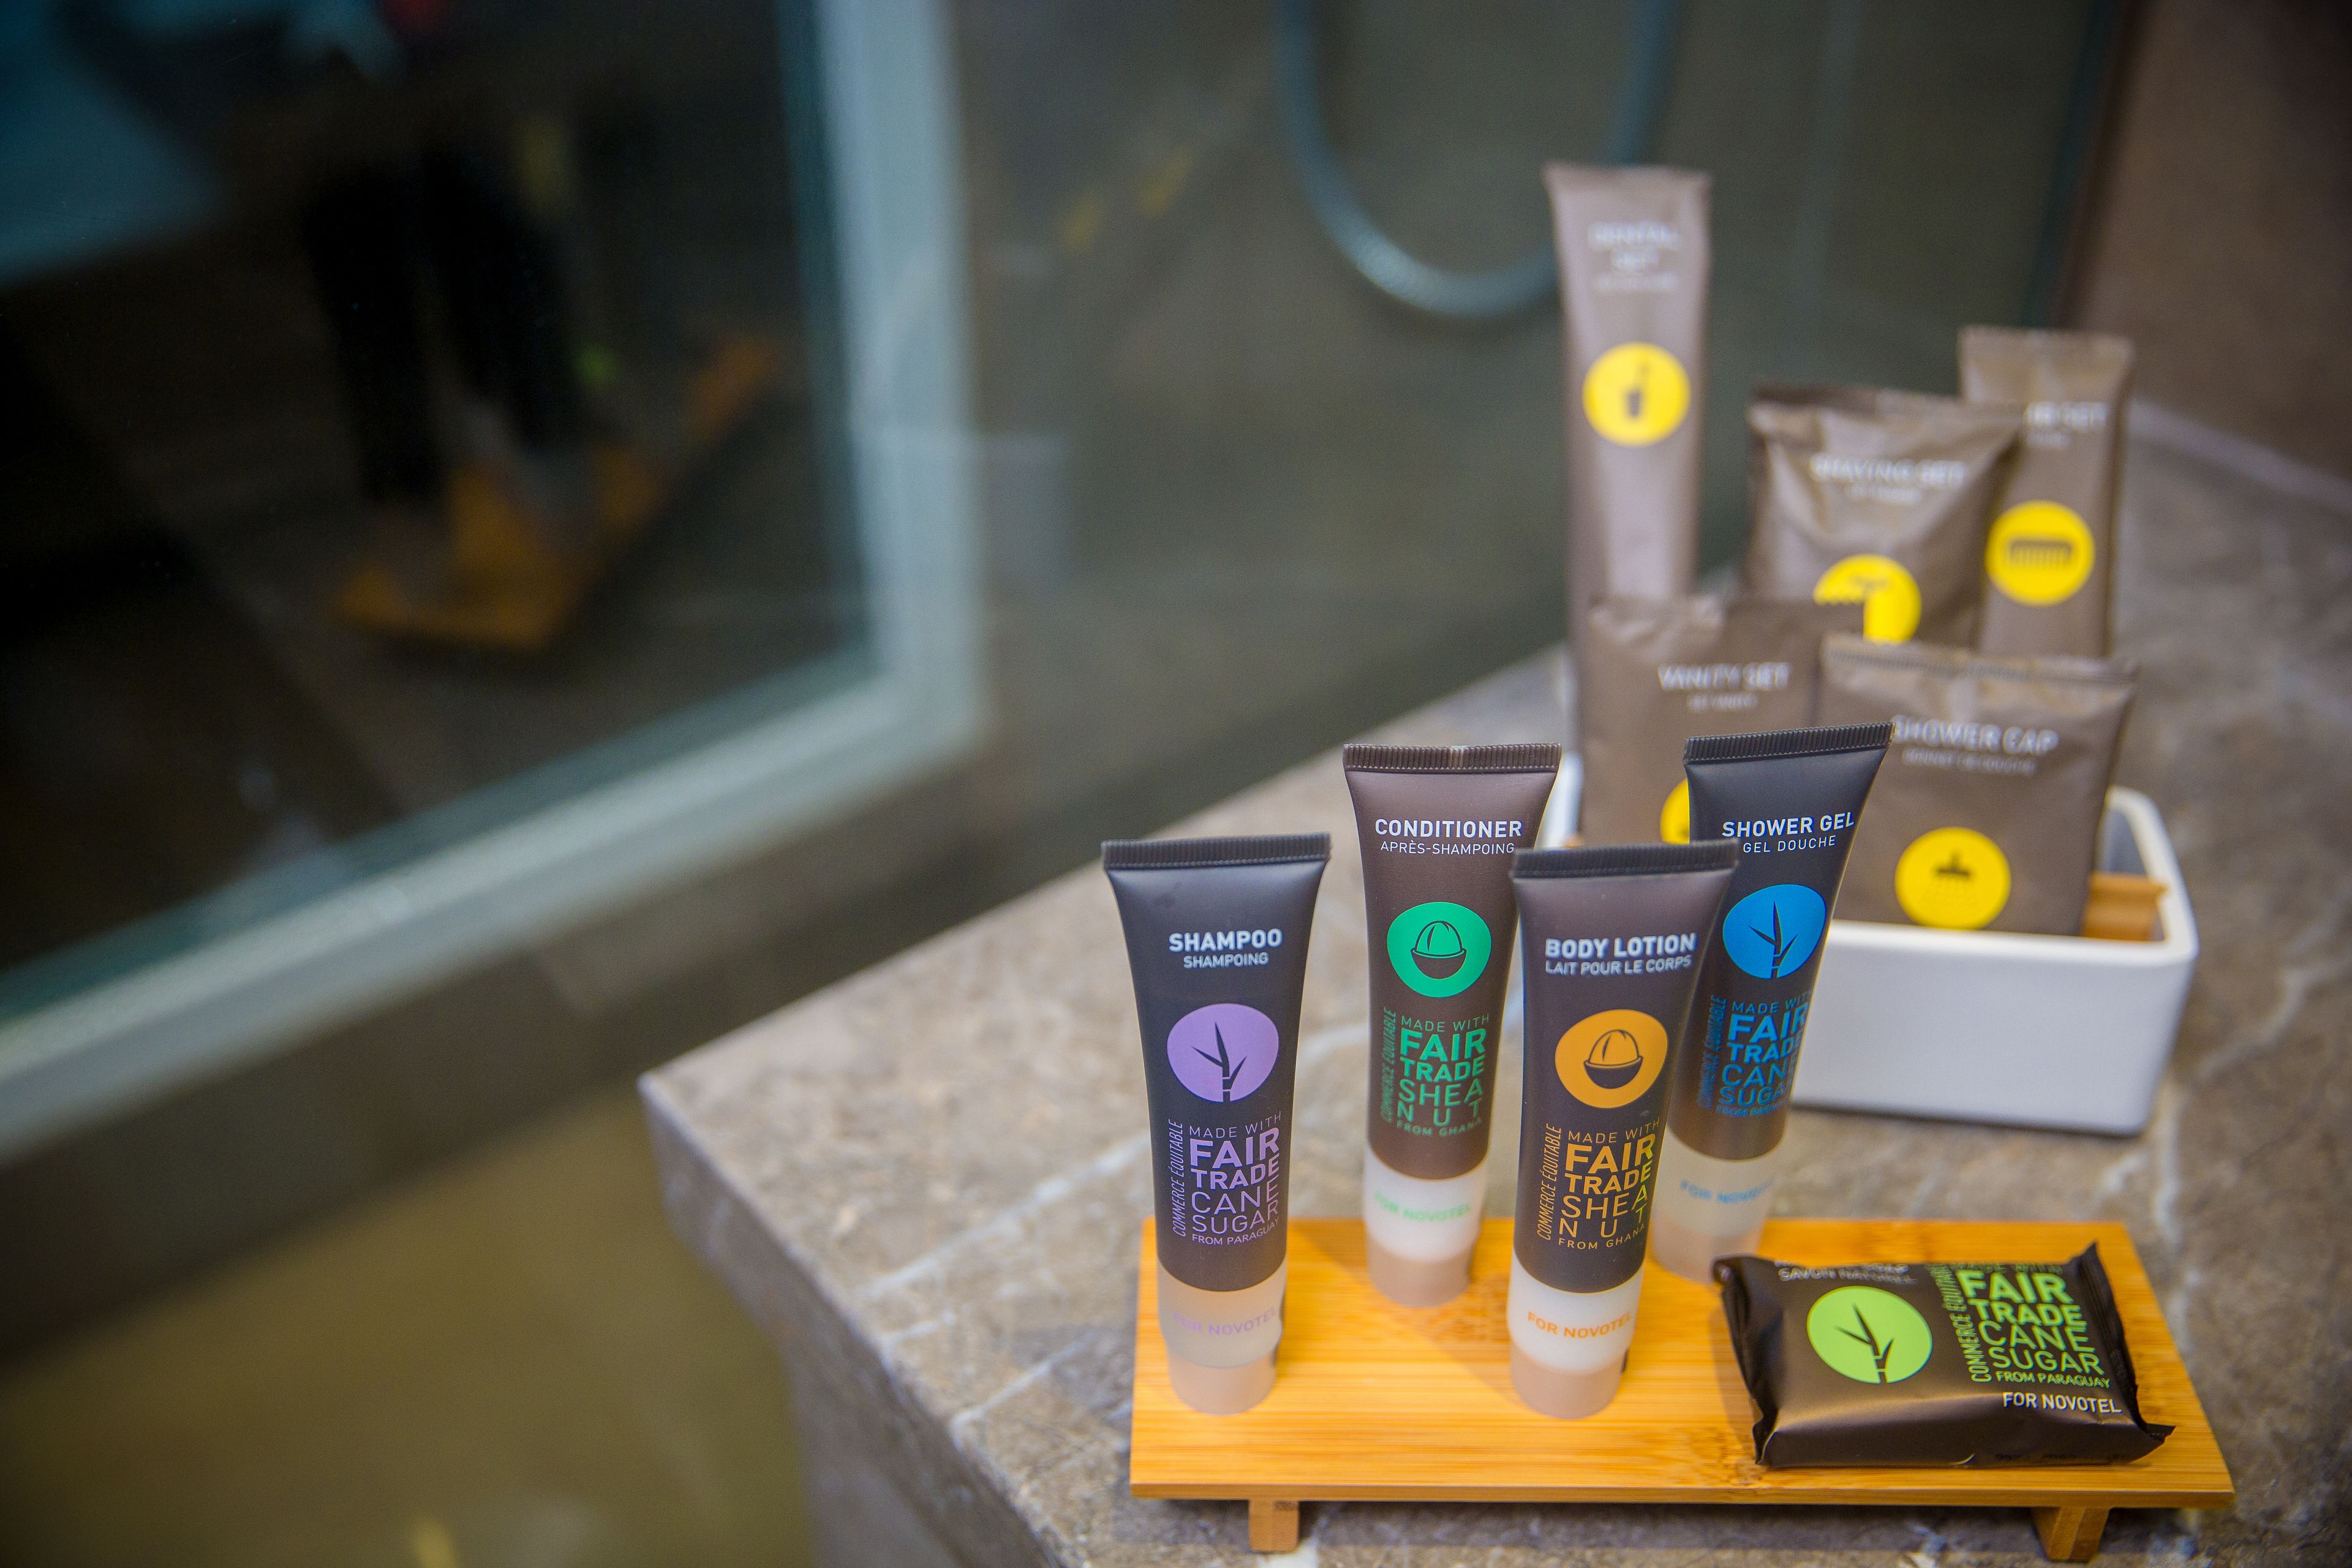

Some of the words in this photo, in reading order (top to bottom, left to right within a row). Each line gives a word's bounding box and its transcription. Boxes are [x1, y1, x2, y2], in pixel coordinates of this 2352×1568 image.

[1657, 664, 1743, 690] VANITY
[1744, 662, 1791, 690] SET
[1891, 715, 2001, 752] SHOWER
[2003, 726, 2060, 755] CAP
[1375, 818, 1521, 839] CONDITIONER
[1722, 817, 1813, 837] SHOWER
[1819, 812, 1855, 832] GEL
[1380, 840, 1515, 855] APRÈS-SHAMPOING
[1743, 842, 1771, 853] GEL
[1777, 835, 1836, 852] DOUCHE
[1169, 929, 1283, 952] SHAMPOO
[1545, 938, 1609, 959] BODY
[1614, 932, 1697, 958] LOTION
[1183, 952, 1269, 969] SHAMPOING
[1545, 960, 1577, 975] LAIT
[1580, 960, 1623, 976] POUR
[1624, 959, 1644, 974] LE
[1646, 954, 1692, 974] CORPS
[1401, 1016, 1446, 1032] MADE
[1452, 1013, 1490, 1031] WITH
[1728, 1002, 1810, 1043] FAIR
[1732, 1001, 1779, 1015] MADE
[1400, 1027, 1487, 1062] FAIR
[1400, 1054, 1486, 1083] TRADE
[1398, 1078, 1483, 1107] SHEA
[1189, 1126, 1237, 1138] MADE
[1245, 1111, 1281, 1134] WITH
[1397, 1097, 1482, 1127] NUT
[1568, 1130, 1618, 1144] MADE
[1625, 1117, 1660, 1140] WITH
[1168, 1119, 1184, 1178] ÉQUITABLE
[1190, 1128, 1280, 1169] FAIR
[1539, 1123, 1561, 1182] ÉQUITABLE
[1565, 1134, 1656, 1174] FAIR
[1191, 1153, 1280, 1189] TRADE
[1564, 1160, 1653, 1194] TRADE
[1171, 1176, 1186, 1237] COMMERCE
[1191, 1174, 1279, 1215] CANE
[1561, 1185, 1648, 1219] SHEA
[1192, 1199, 1278, 1234] SUGAR
[1537, 1180, 1557, 1240] COMMERCE
[1559, 1203, 1648, 1238] NUT
[1192, 1234, 1223, 1245] FROM
[1227, 1216, 1279, 1245] PARAGUAY
[1558, 1237, 1597, 1250] FROM
[1606, 1223, 1646, 1248] GHANA
[1956, 1269, 2074, 1303] FAIR
[1528, 1311, 1559, 1334] FOR
[1563, 1311, 1632, 1339] NOVOTEL
[1967, 1297, 2088, 1327] TRADE
[1950, 1313, 1992, 1382] COMMERCE
[1978, 1320, 2095, 1352] CANE
[1988, 1346, 2105, 1376] SUGAR
[1996, 1371, 2035, 1383] FROM
[2038, 1373, 2111, 1389] PARAGUAY
[2002, 1391, 2038, 1408] FOR
[2041, 1393, 2122, 1414] NOVOTEL
